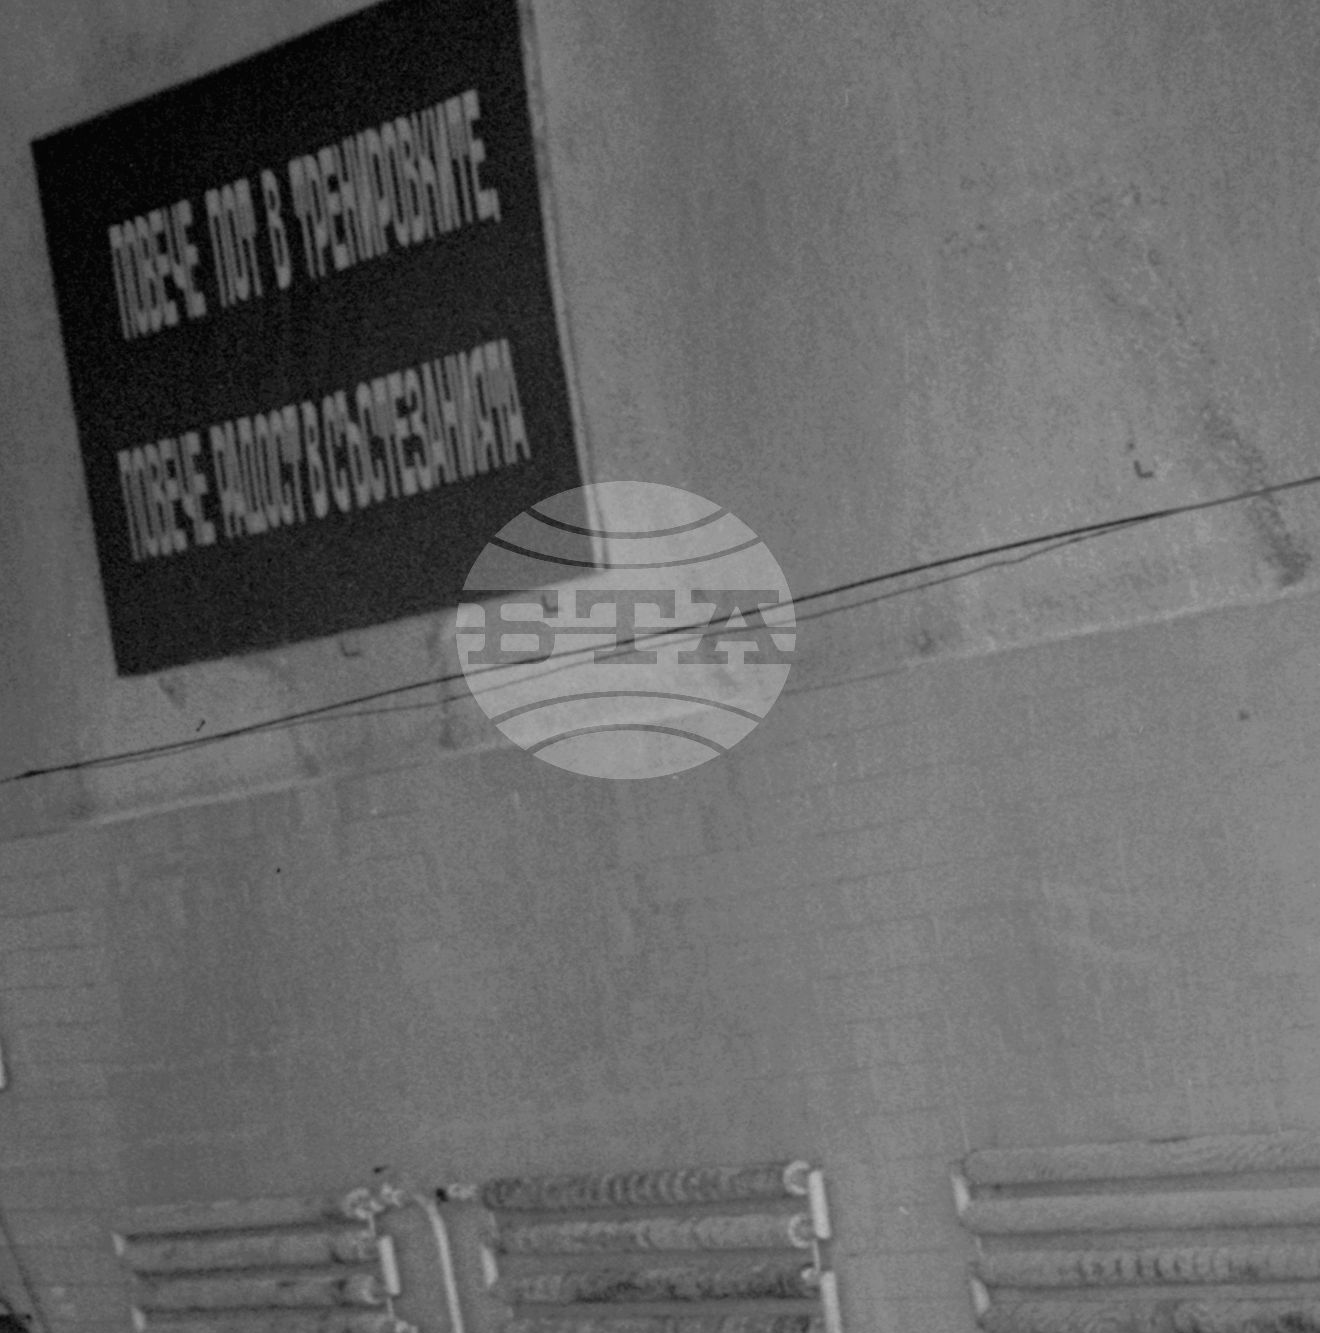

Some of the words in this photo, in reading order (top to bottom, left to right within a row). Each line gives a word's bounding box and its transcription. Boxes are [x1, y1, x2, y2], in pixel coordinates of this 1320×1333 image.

[108, 199, 207, 341] ПОВЕЧЕ
[205, 178, 263, 308] ПОТ
[260, 168, 292, 290] В
[117, 431, 216, 562] ПОВЕЧЕ
[209, 404, 306, 543] РАДОСТ
[301, 400, 329, 519] В
[321, 338, 531, 513] СЪСТЕЗАНИЯТА
